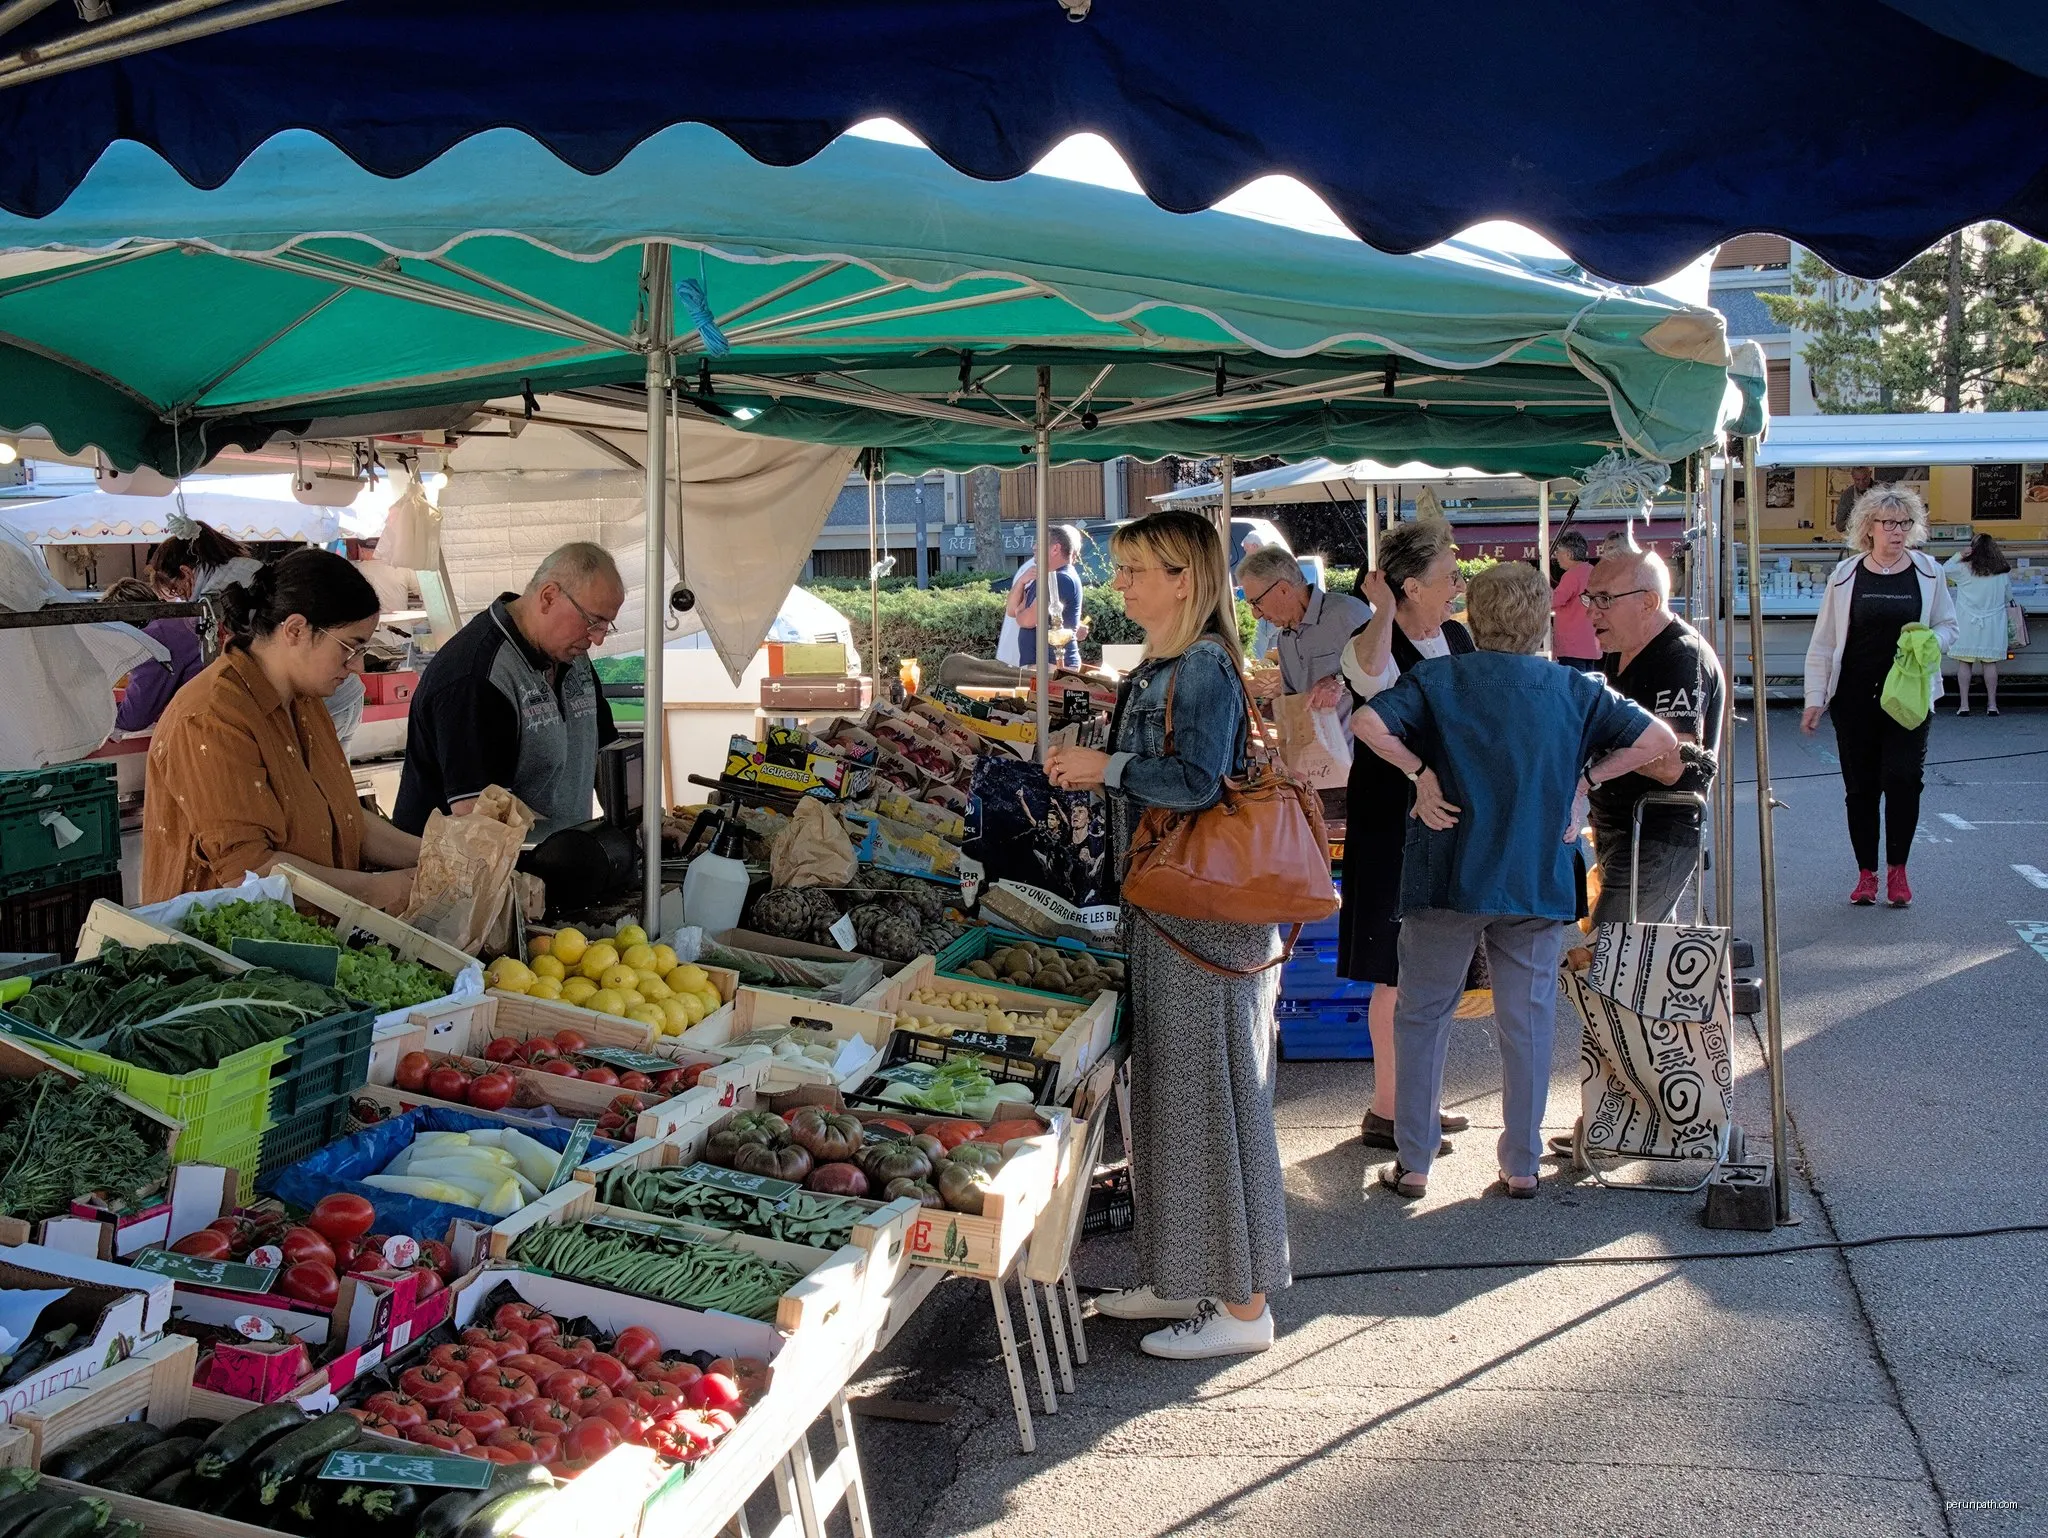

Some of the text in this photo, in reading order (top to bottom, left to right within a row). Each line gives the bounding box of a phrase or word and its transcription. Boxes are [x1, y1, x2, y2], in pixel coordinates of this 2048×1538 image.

[760, 764, 810, 784] AGUACATE
[1028, 888, 1052, 907] UNIS
[1049, 900, 1088, 924] DERRIÈRE
[1090, 911, 1105, 923] LES
